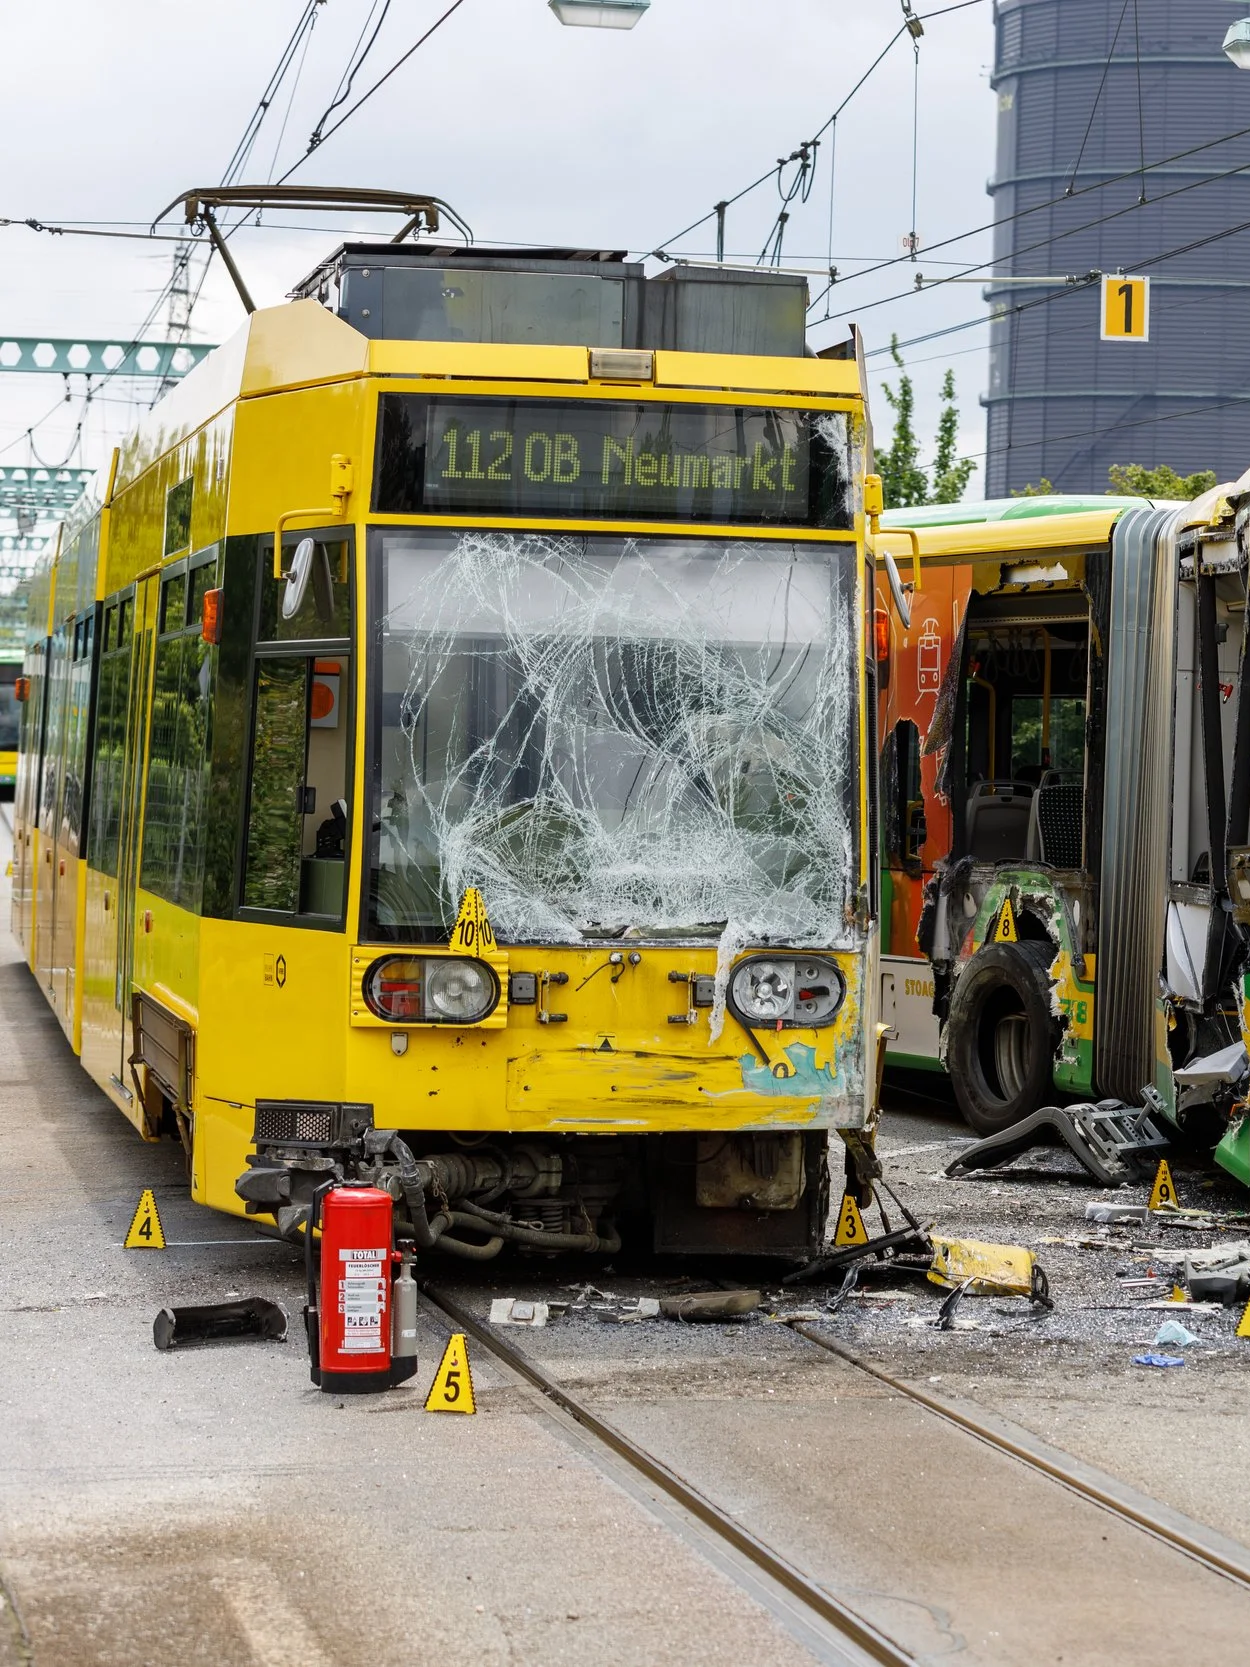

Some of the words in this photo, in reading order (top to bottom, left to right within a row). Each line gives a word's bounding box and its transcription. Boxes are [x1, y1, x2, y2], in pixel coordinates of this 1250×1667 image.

[1118, 284, 1133, 333] 1
[441, 429, 513, 480] 112
[524, 432, 580, 482] OB
[602, 435, 796, 491] Neumarkt
[458, 918, 475, 947] 10
[479, 918, 492, 947] 10
[1002, 918, 1010, 937] 8
[904, 978, 935, 998] STOAG
[1159, 1183, 1170, 1203] 9
[138, 1216, 153, 1241] 4
[845, 1214, 857, 1239] 3
[353, 1250, 377, 1259] TOTAL
[339, 1304, 345, 1313] 3
[340, 1292, 345, 1301] 2
[443, 1370, 461, 1403] 5
